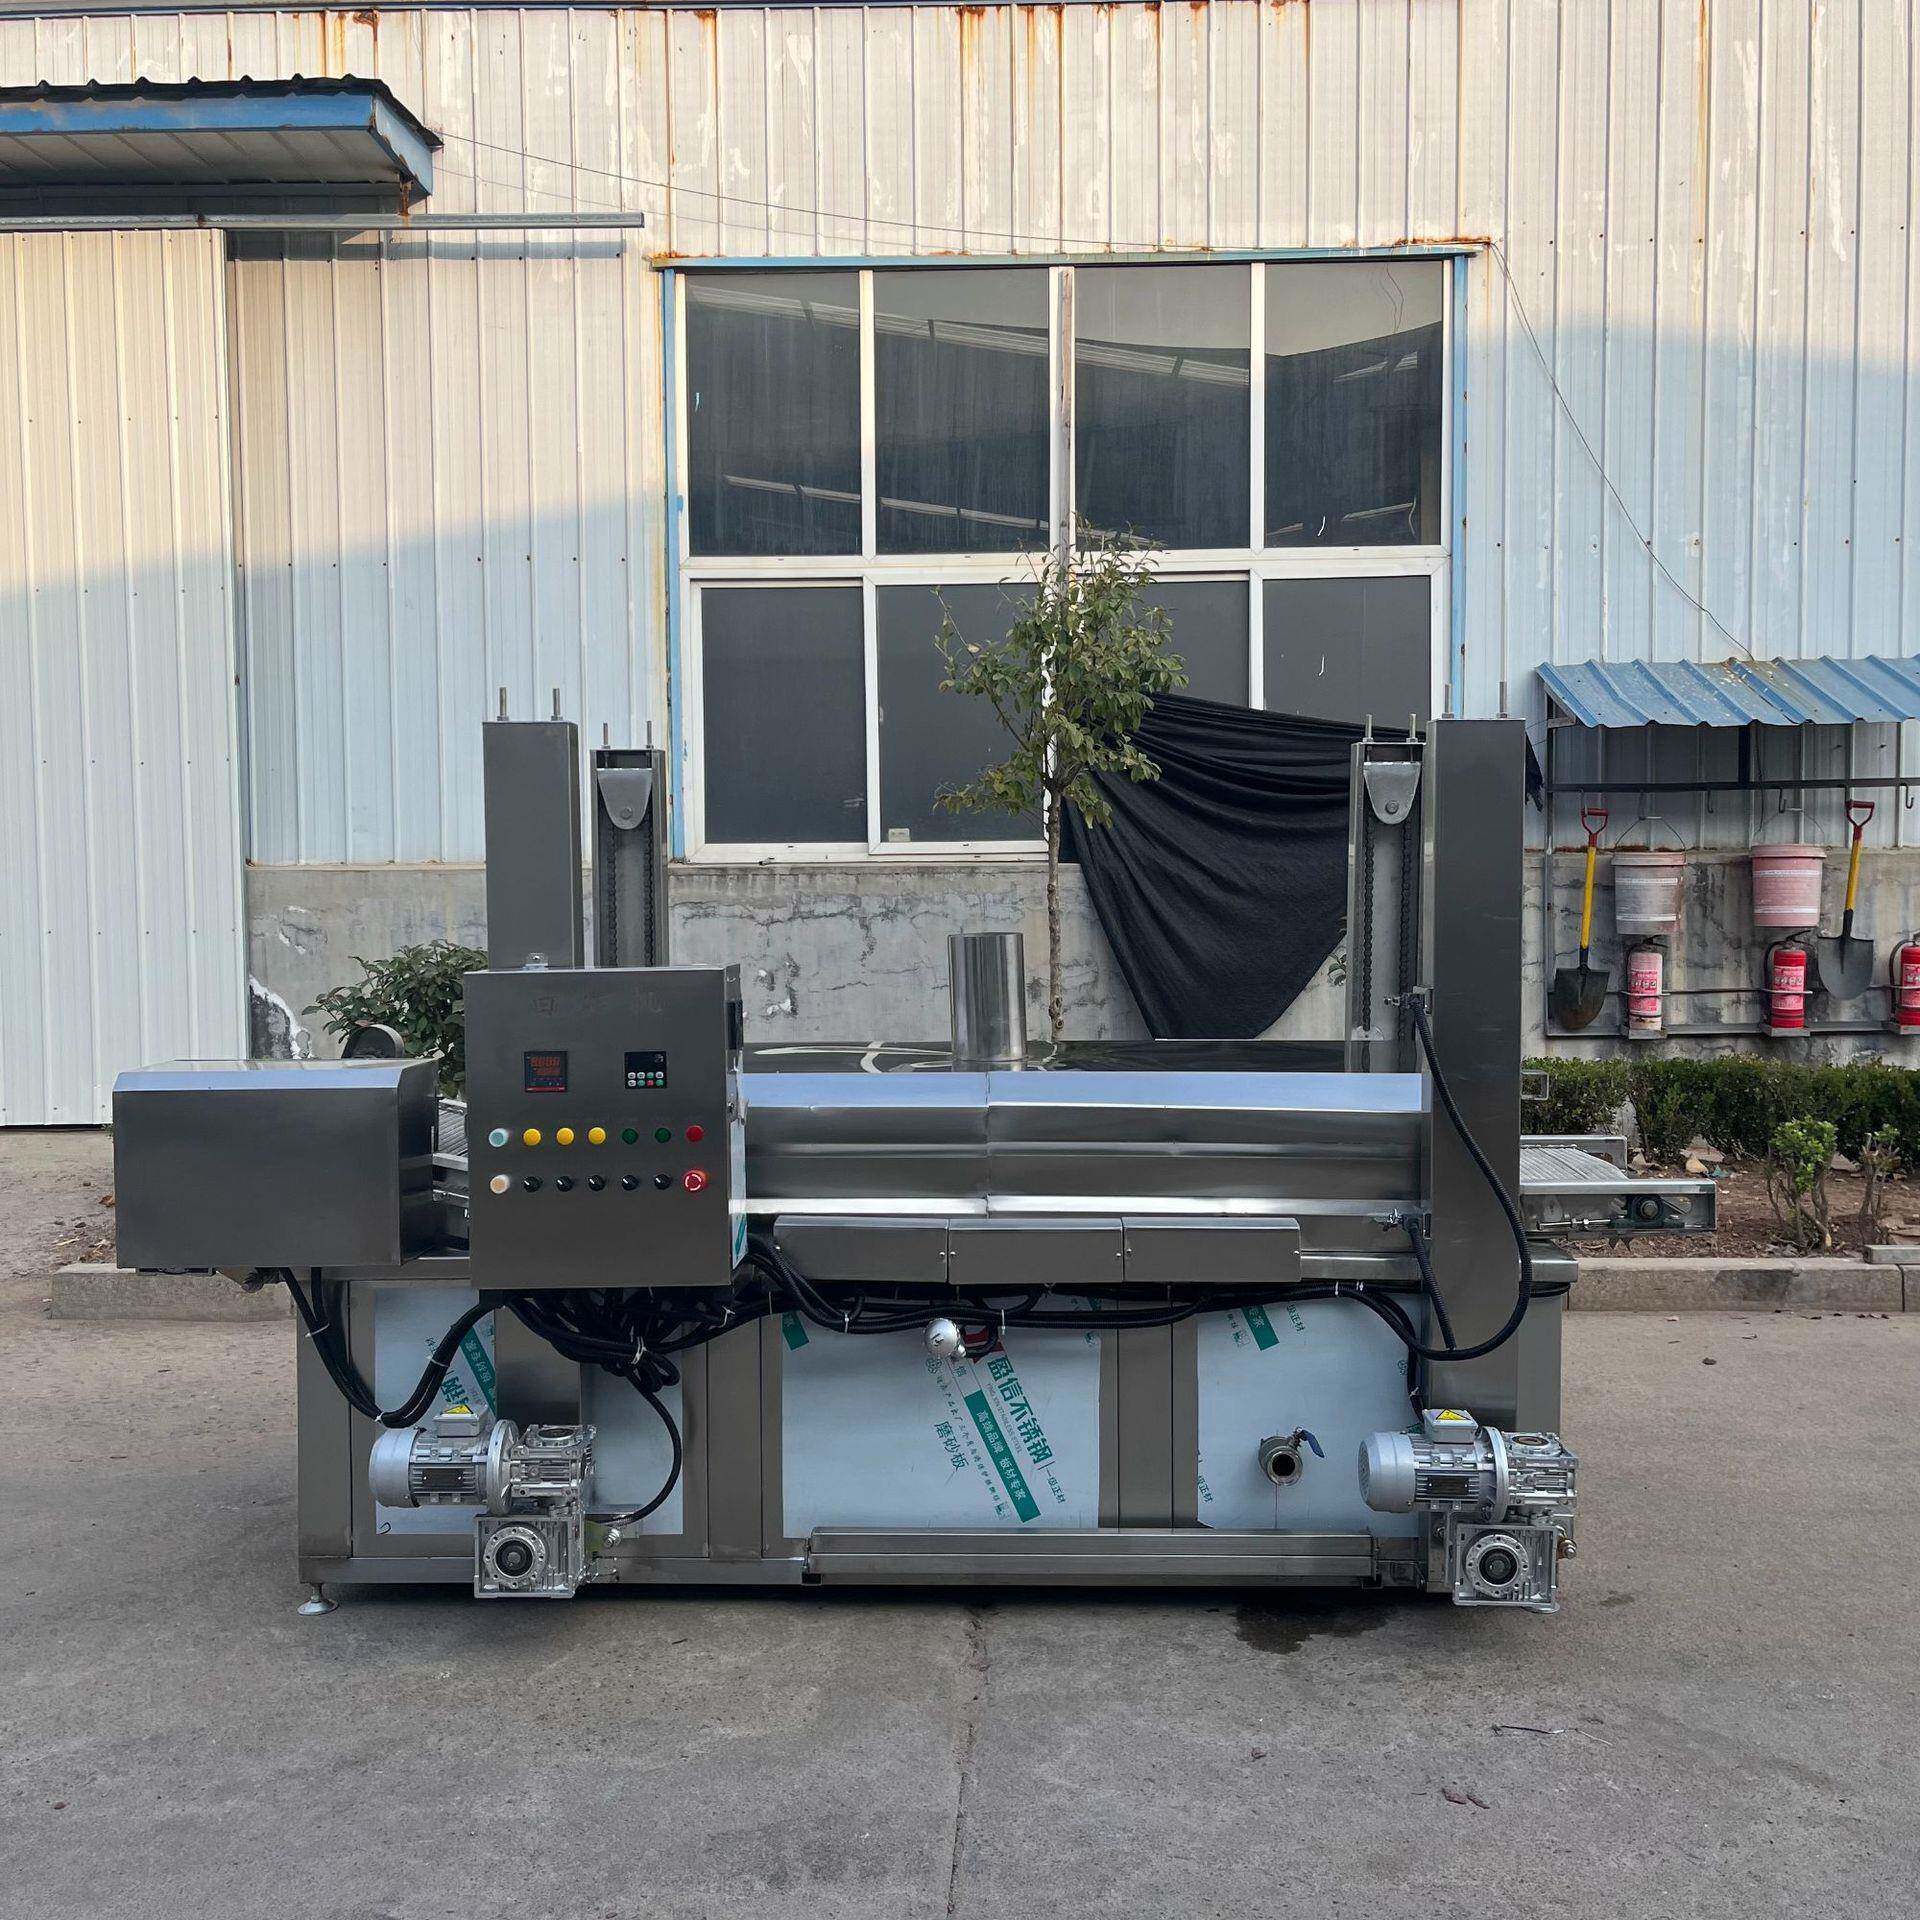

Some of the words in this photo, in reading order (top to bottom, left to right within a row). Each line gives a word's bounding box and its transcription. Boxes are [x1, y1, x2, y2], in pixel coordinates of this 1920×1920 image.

[934, 1420, 969, 1472] 磨砂板
[986, 1354, 1053, 1465] 盈信不锈钢
